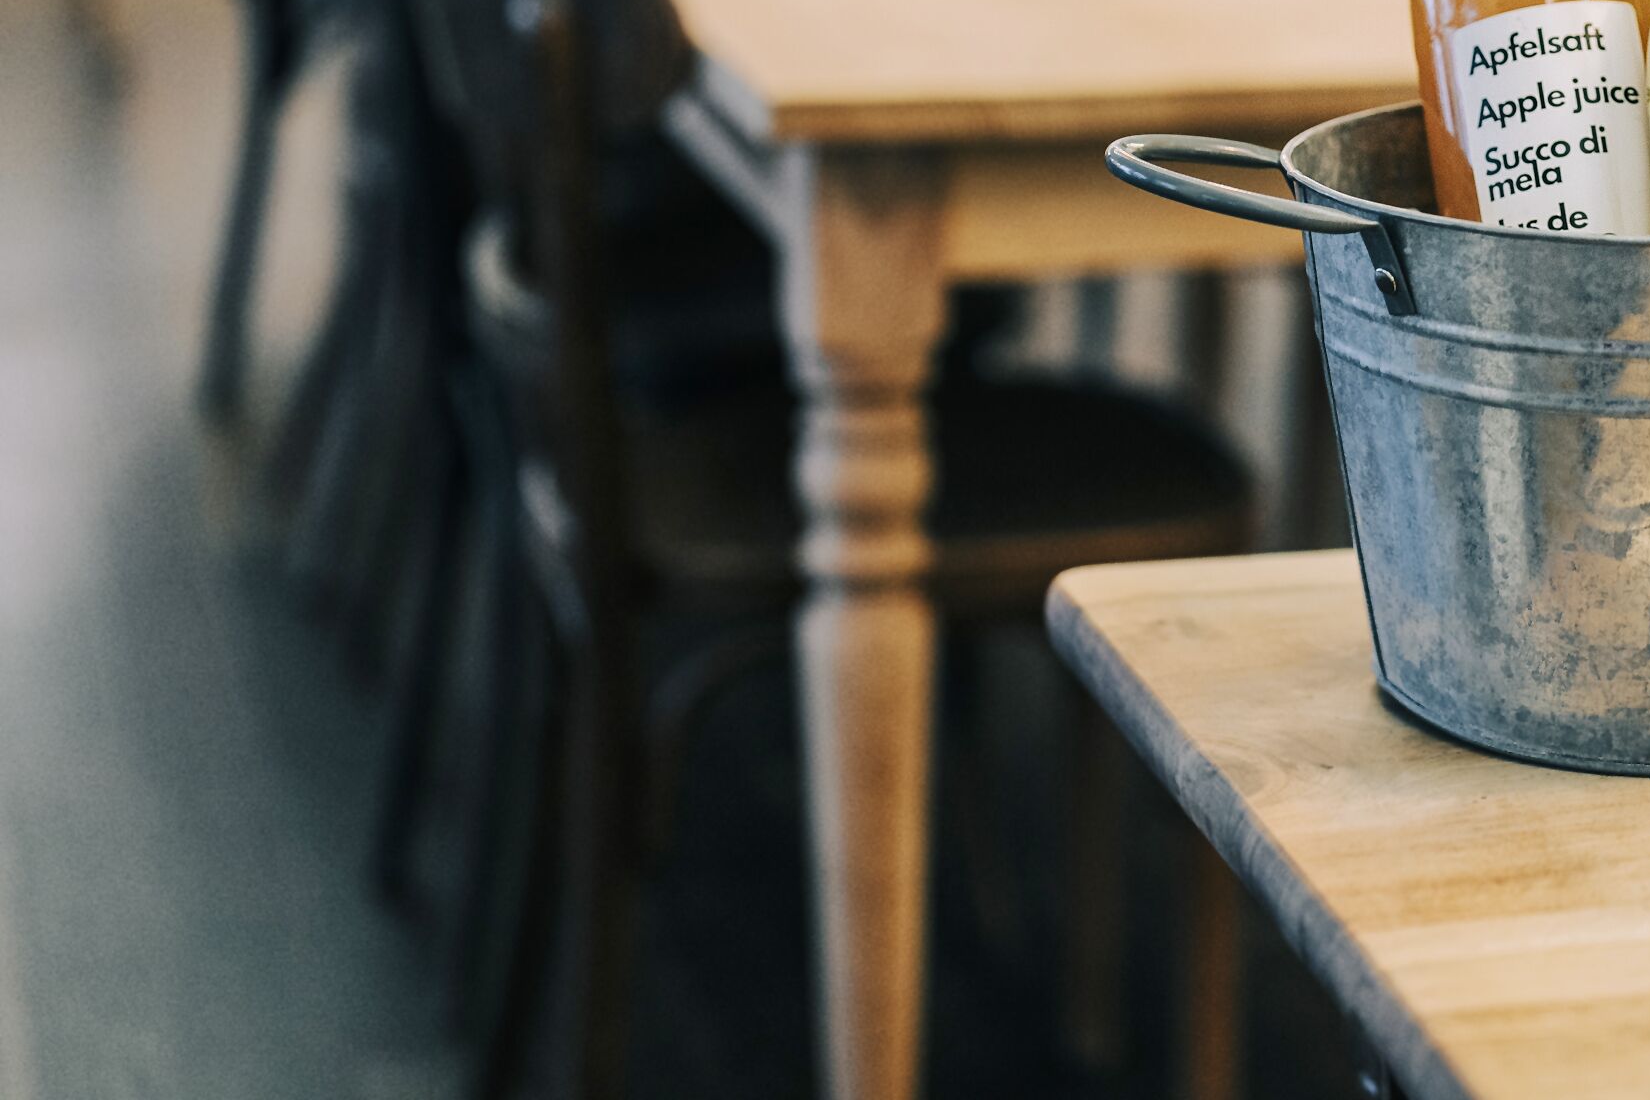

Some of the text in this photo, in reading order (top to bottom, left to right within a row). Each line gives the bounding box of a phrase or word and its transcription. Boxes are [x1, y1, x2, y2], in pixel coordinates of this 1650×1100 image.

[1469, 23, 1605, 76] Apfelsaft
[1477, 76, 1640, 128] Apple juice
[1485, 125, 1608, 176] Succo di
[1488, 158, 1563, 202] mela
[1547, 202, 1588, 231] de
